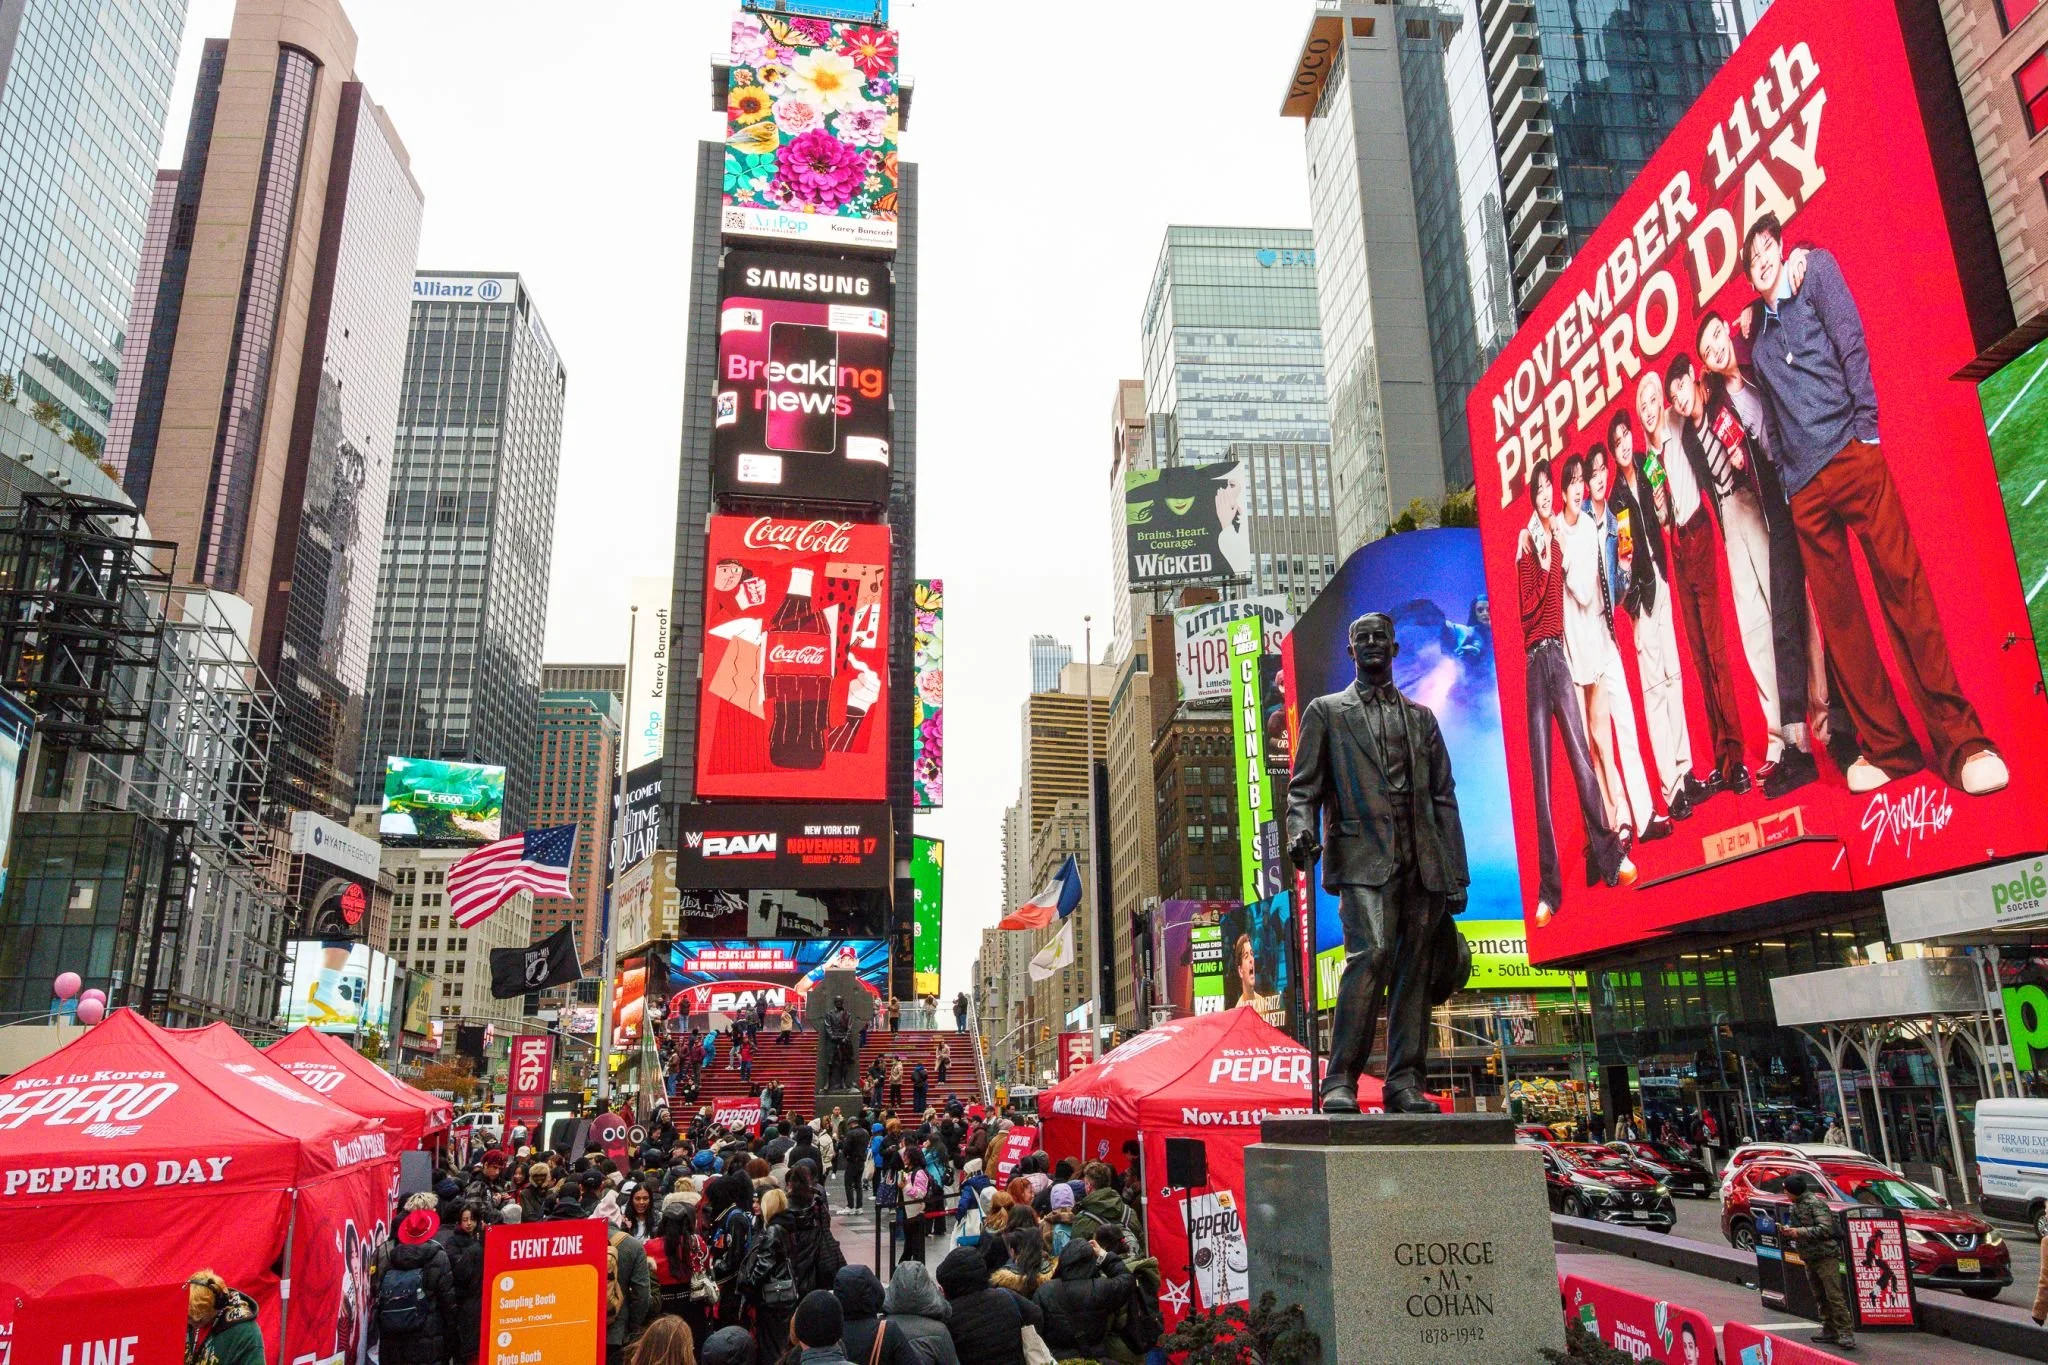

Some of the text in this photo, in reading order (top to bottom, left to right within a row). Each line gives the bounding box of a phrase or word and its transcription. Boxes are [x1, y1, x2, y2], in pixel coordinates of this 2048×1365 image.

[831, 224, 893, 237] Karey Bancroft
[1491, 41, 1821, 443] NOVEMBER 11th
[413, 281, 473, 296] Allianz
[746, 268, 870, 296] SAMSUNG
[1496, 88, 1828, 510] PEPERO DAY
[728, 354, 883, 398] Breaking
[754, 389, 853, 415] news
[1136, 527, 1209, 542] Brains. Heart.
[1150, 538, 1197, 550] Courage.
[1186, 603, 1284, 639] LITTLE SHOP
[651, 608, 668, 699] Karey Bancroft
[1241, 659, 1263, 862] CANNABIS
[427, 793, 464, 805] K-FOOD
[804, 825, 860, 835] NEW YORK CITY
[323, 832, 377, 866] HYATT REGENCY
[702, 833, 777, 857] RAW
[787, 838, 877, 854] NOVEMBER 17
[802, 855, 831, 864] MONDAY
[2007, 899, 2040, 913] SOCCER
[700, 950, 717, 959] JOHN
[740, 950, 756, 959] LAST
[757, 950, 772, 959] TIME
[773, 950, 782, 959] AT
[687, 961, 699, 970] THE
[728, 961, 745, 970] MOST
[746, 961, 772, 970] FAMOUS
[773, 961, 794, 970] ARENA
[1498, 962, 1531, 977] 50th
[711, 987, 786, 1012] RAW
[1068, 1036, 1093, 1074] tkt
[1222, 1047, 1252, 1057] No.1
[1255, 1047, 1271, 1056] in
[295, 1061, 337, 1070] Korea
[513, 1038, 545, 1092] tkts
[12, 1069, 168, 1091] No.1 in Korea
[1997, 1133, 2048, 1147] FERRARI EXP
[1008, 1148, 1021, 1160] ZONE
[3, 1156, 233, 1195] PEPERO DAY
[1849, 1221, 1872, 1233] BEAT
[510, 1235, 583, 1260] EVENT ZONE
[1851, 1232, 1872, 1249] IT
[1394, 1242, 1494, 1266] GEORGE
[1881, 1245, 1903, 1260] BAD
[1438, 1269, 1460, 1291] M
[500, 1293, 556, 1310] Sampling Booth
[1406, 1293, 1494, 1317] COHAN
[1882, 1293, 1910, 1308] JAM
[1420, 1327, 1484, 1345] 1878-1942
[1632, 1326, 1646, 1338] Korea
[497, 1350, 542, 1365] Photo Booth
